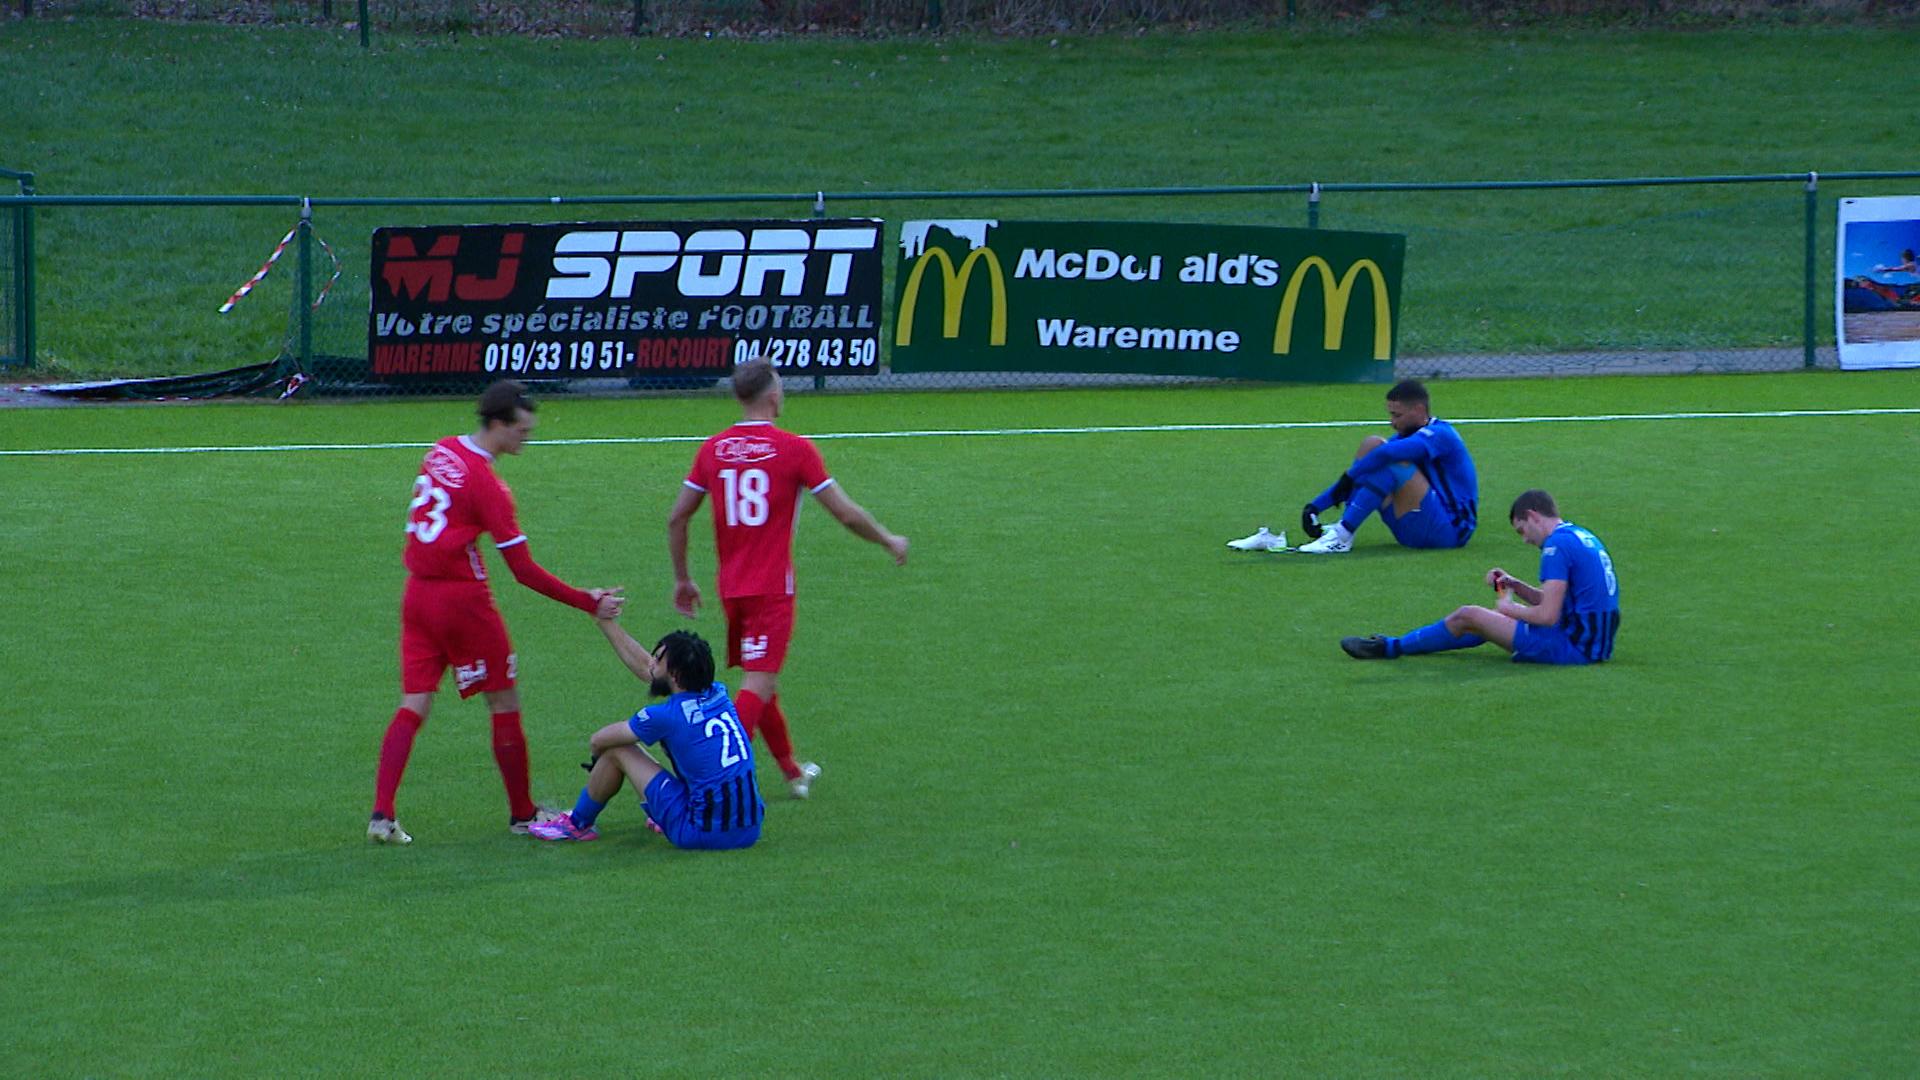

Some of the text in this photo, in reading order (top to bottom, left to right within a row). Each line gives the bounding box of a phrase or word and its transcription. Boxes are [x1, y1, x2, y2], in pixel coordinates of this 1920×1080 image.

[383, 228, 878, 302] MJ SPORT
[375, 304, 875, 338] Votre spécialiste FOOTBALL
[1036, 318, 1241, 353] Waremme
[373, 342, 481, 374] WAREMME
[484, 340, 561, 374] 019/33
[569, 340, 595, 371] 19
[636, 337, 732, 369] ROCOURT
[733, 337, 811, 369] 04/278
[816, 338, 844, 367] 43
[848, 338, 877, 367] 50
[404, 474, 452, 544] 23
[718, 468, 771, 527] 18
[704, 711, 749, 768] 21
